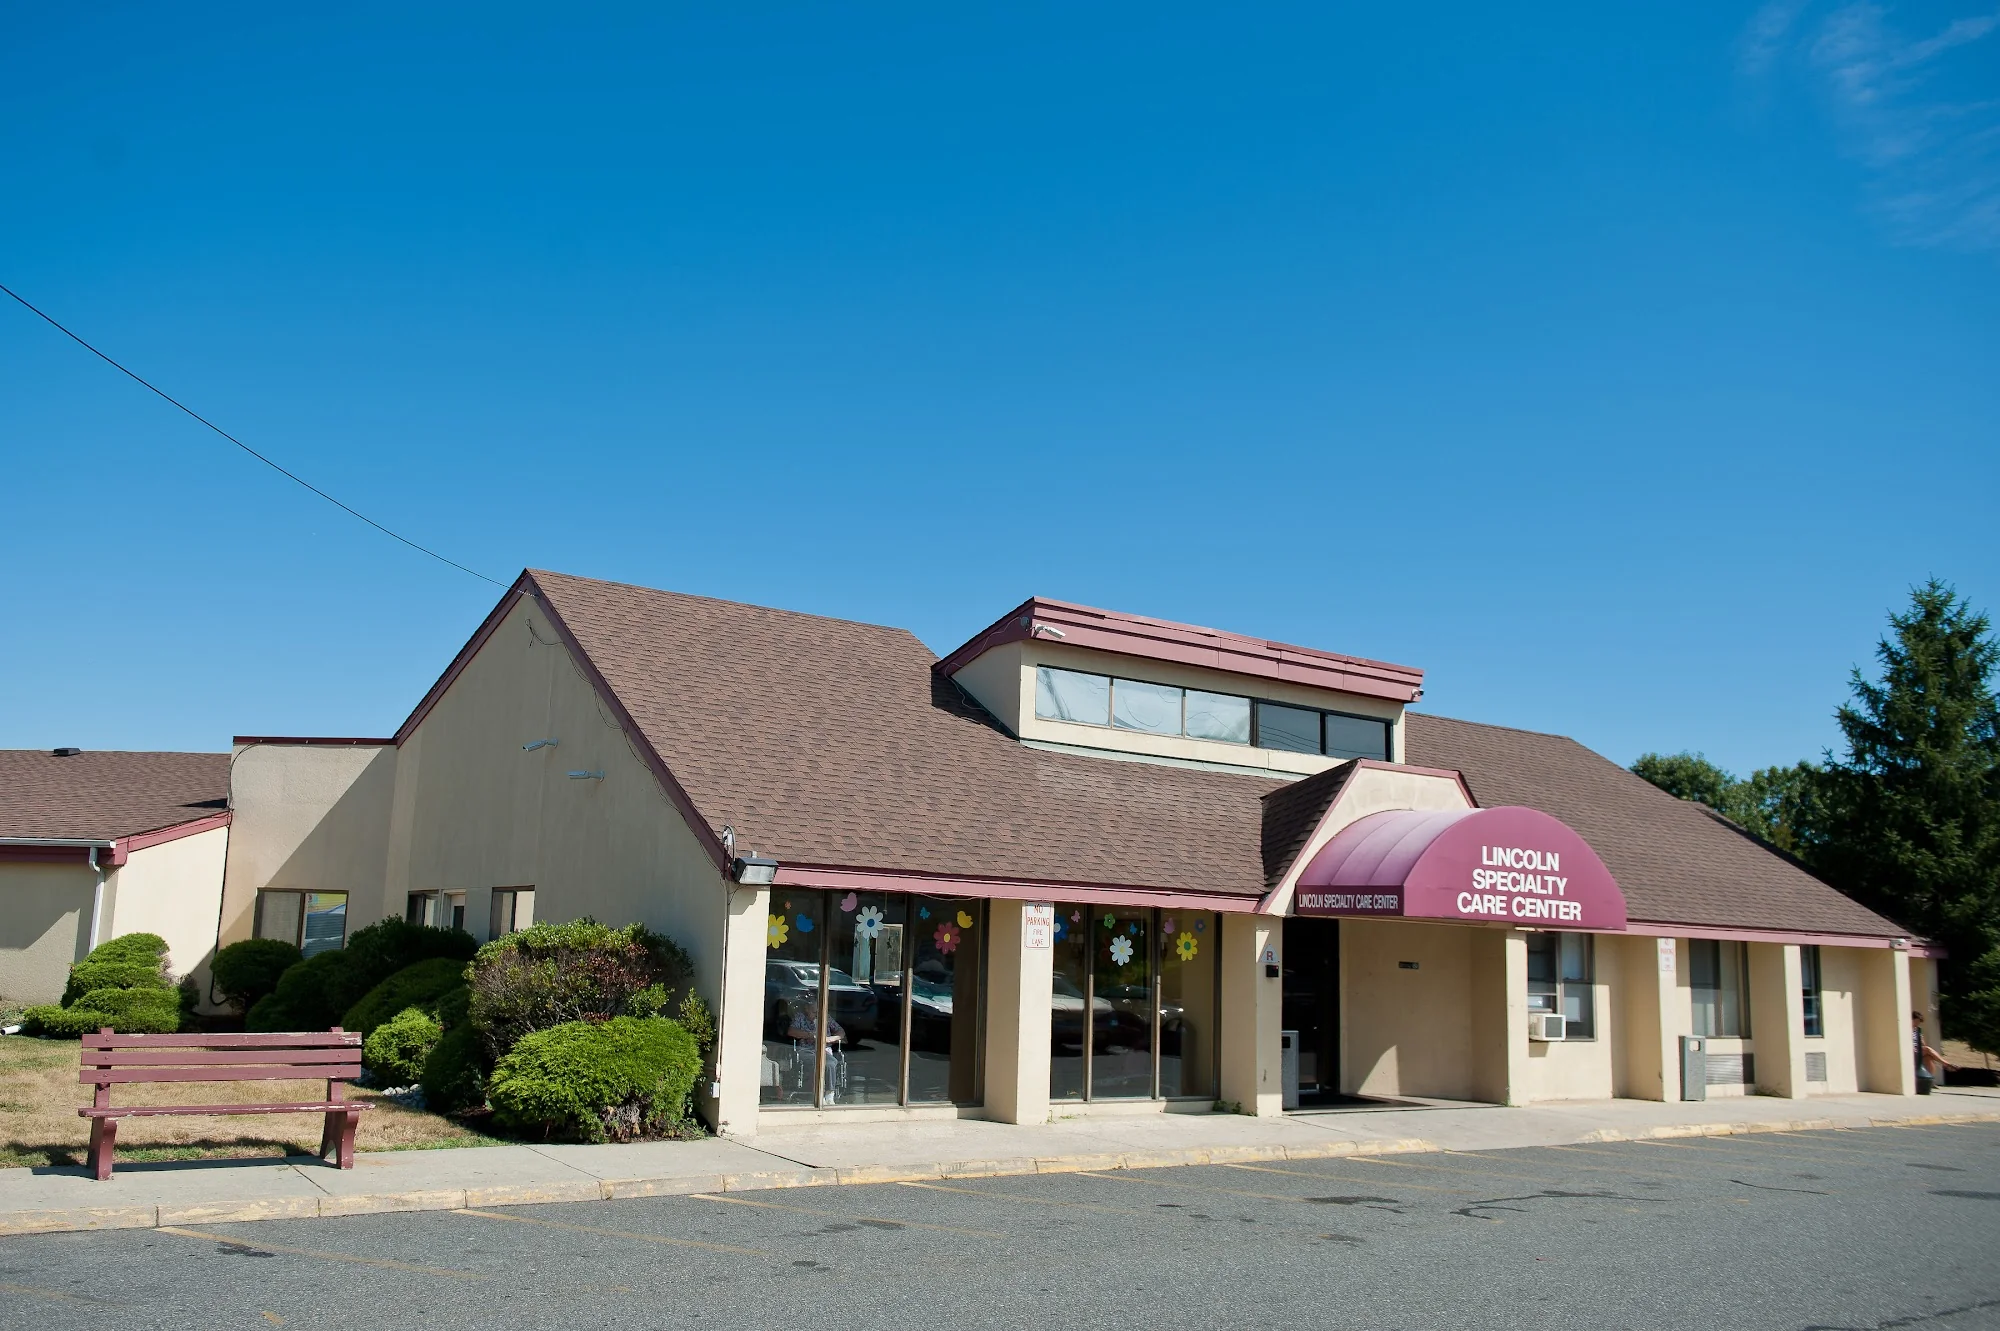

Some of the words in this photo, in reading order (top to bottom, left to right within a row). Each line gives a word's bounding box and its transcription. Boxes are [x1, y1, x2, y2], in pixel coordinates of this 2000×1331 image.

[1482, 846, 1559, 871] LINCOLN
[1472, 868, 1567, 896] SPECIALTY
[1034, 904, 1043, 914] NO
[1299, 894, 1323, 908] LINCOLN
[1324, 894, 1355, 908] SPECIALTY
[1356, 894, 1372, 909] CARE
[1373, 894, 1398, 909] CENTER
[1457, 892, 1507, 915] CARE
[1512, 896, 1581, 920] CENTER
[1027, 917, 1050, 926] PARKING
[1266, 951, 1274, 961] R
